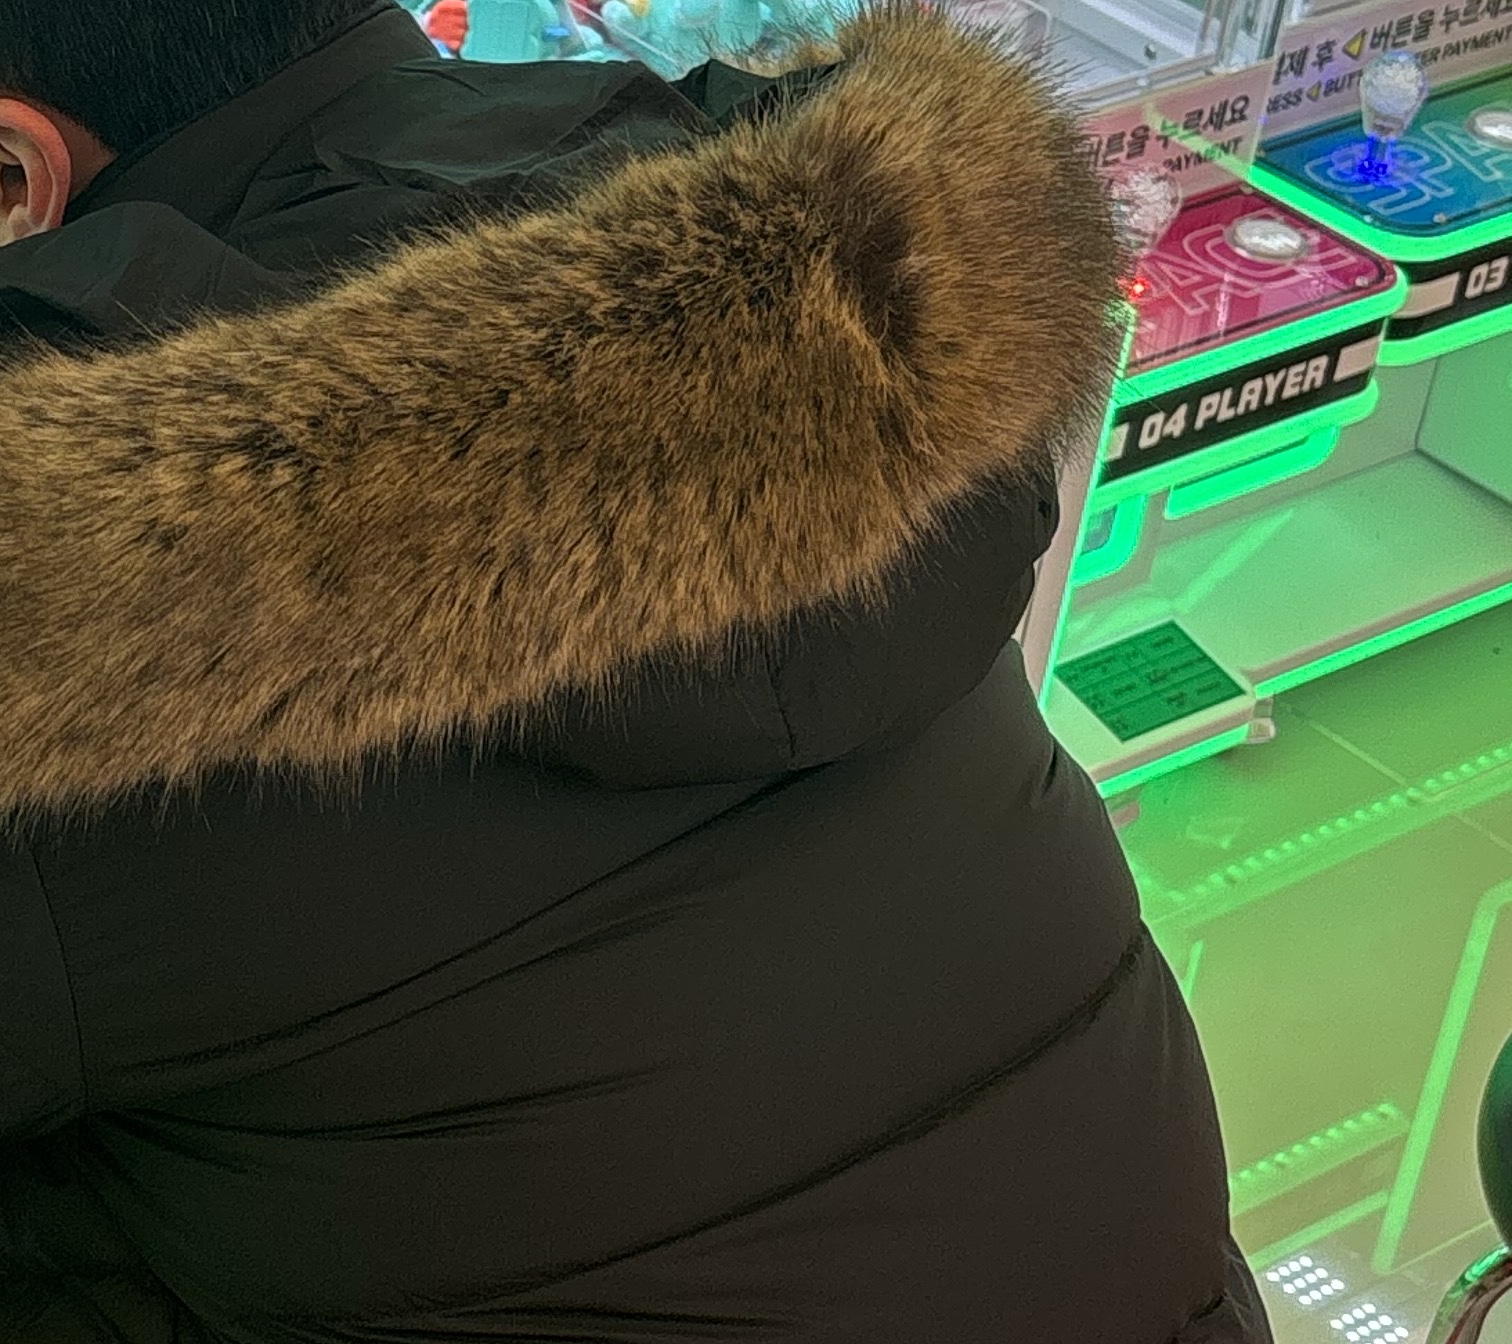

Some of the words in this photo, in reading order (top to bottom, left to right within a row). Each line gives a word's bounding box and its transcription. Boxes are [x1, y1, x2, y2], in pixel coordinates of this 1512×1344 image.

[1465, 258, 1506, 296] 03
[1139, 409, 1185, 448] 04
[1194, 358, 1328, 429] PLAYER
